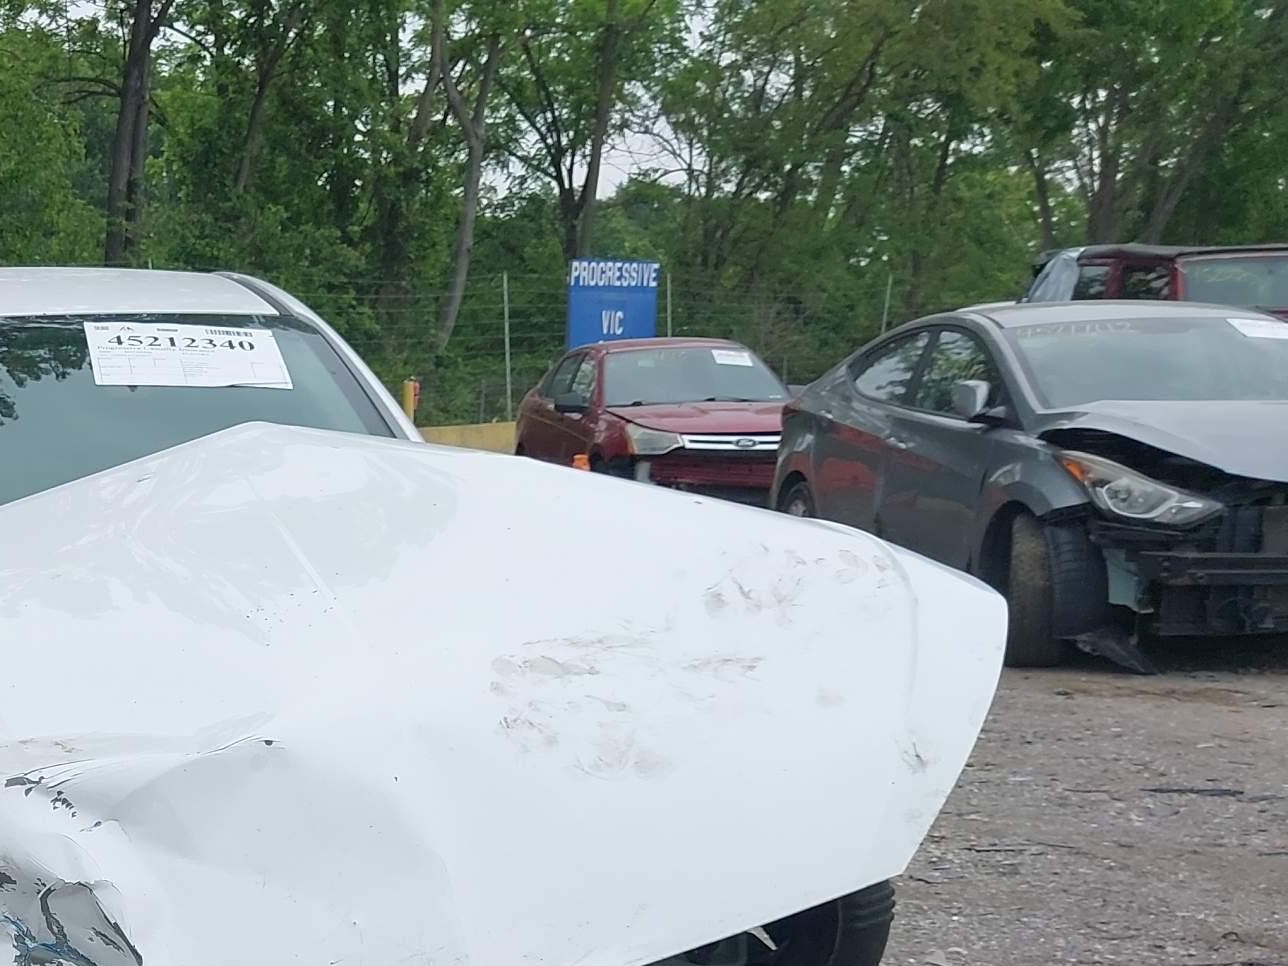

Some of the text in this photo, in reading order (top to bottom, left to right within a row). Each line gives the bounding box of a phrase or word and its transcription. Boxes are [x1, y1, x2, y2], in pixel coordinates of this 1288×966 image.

[571, 261, 660, 288] PROGRESSIVE
[601, 310, 624, 335] VIC
[107, 334, 256, 352] 45212340
